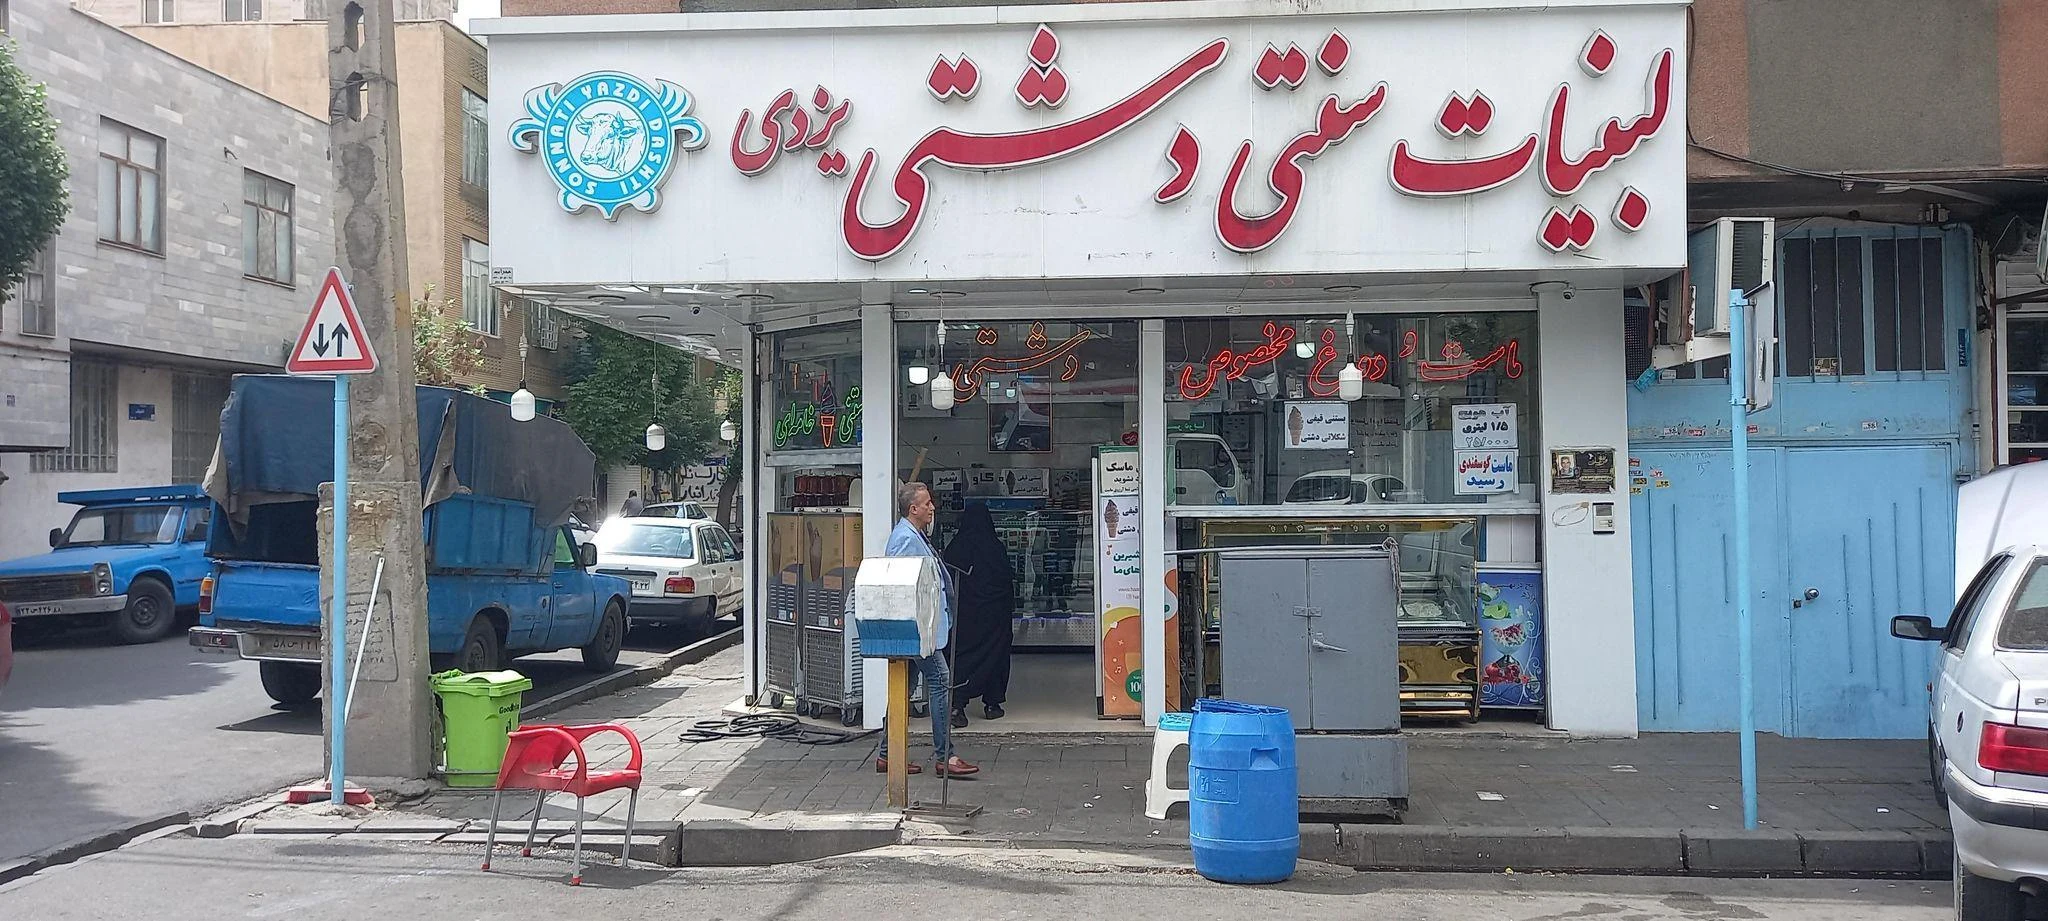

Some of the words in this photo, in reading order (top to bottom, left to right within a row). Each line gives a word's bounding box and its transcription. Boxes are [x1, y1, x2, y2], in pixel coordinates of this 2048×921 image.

[550, 100, 598, 195] SONNATI
[580, 82, 650, 112] YAZDI
[619, 117, 666, 195] DASHTI
[731, 86, 853, 177] یزدی
[1214, 28, 1388, 253] سنتی
[1389, 29, 1673, 252] لبنیات
[841, 24, 1229, 261] دشتی
[1400, 330, 1418, 358] و
[1180, 321, 1296, 400] مخصوص
[1421, 341, 1523, 381] ماست
[1306, 413, 1323, 425] قیفی
[1325, 414, 1346, 425] بستنی
[1462, 421, 1488, 434] لیتری
[1491, 421, 1509, 431] ۱/۵
[1300, 433, 1320, 443] دشتی
[1321, 433, 1347, 443] شکلاتی
[1106, 461, 1134, 472] ماسک
[1458, 454, 1491, 474] گوسفندی
[1491, 454, 1513, 473] ماست
[1466, 476, 1505, 489] رسید
[1117, 526, 1136, 535] دشتی
